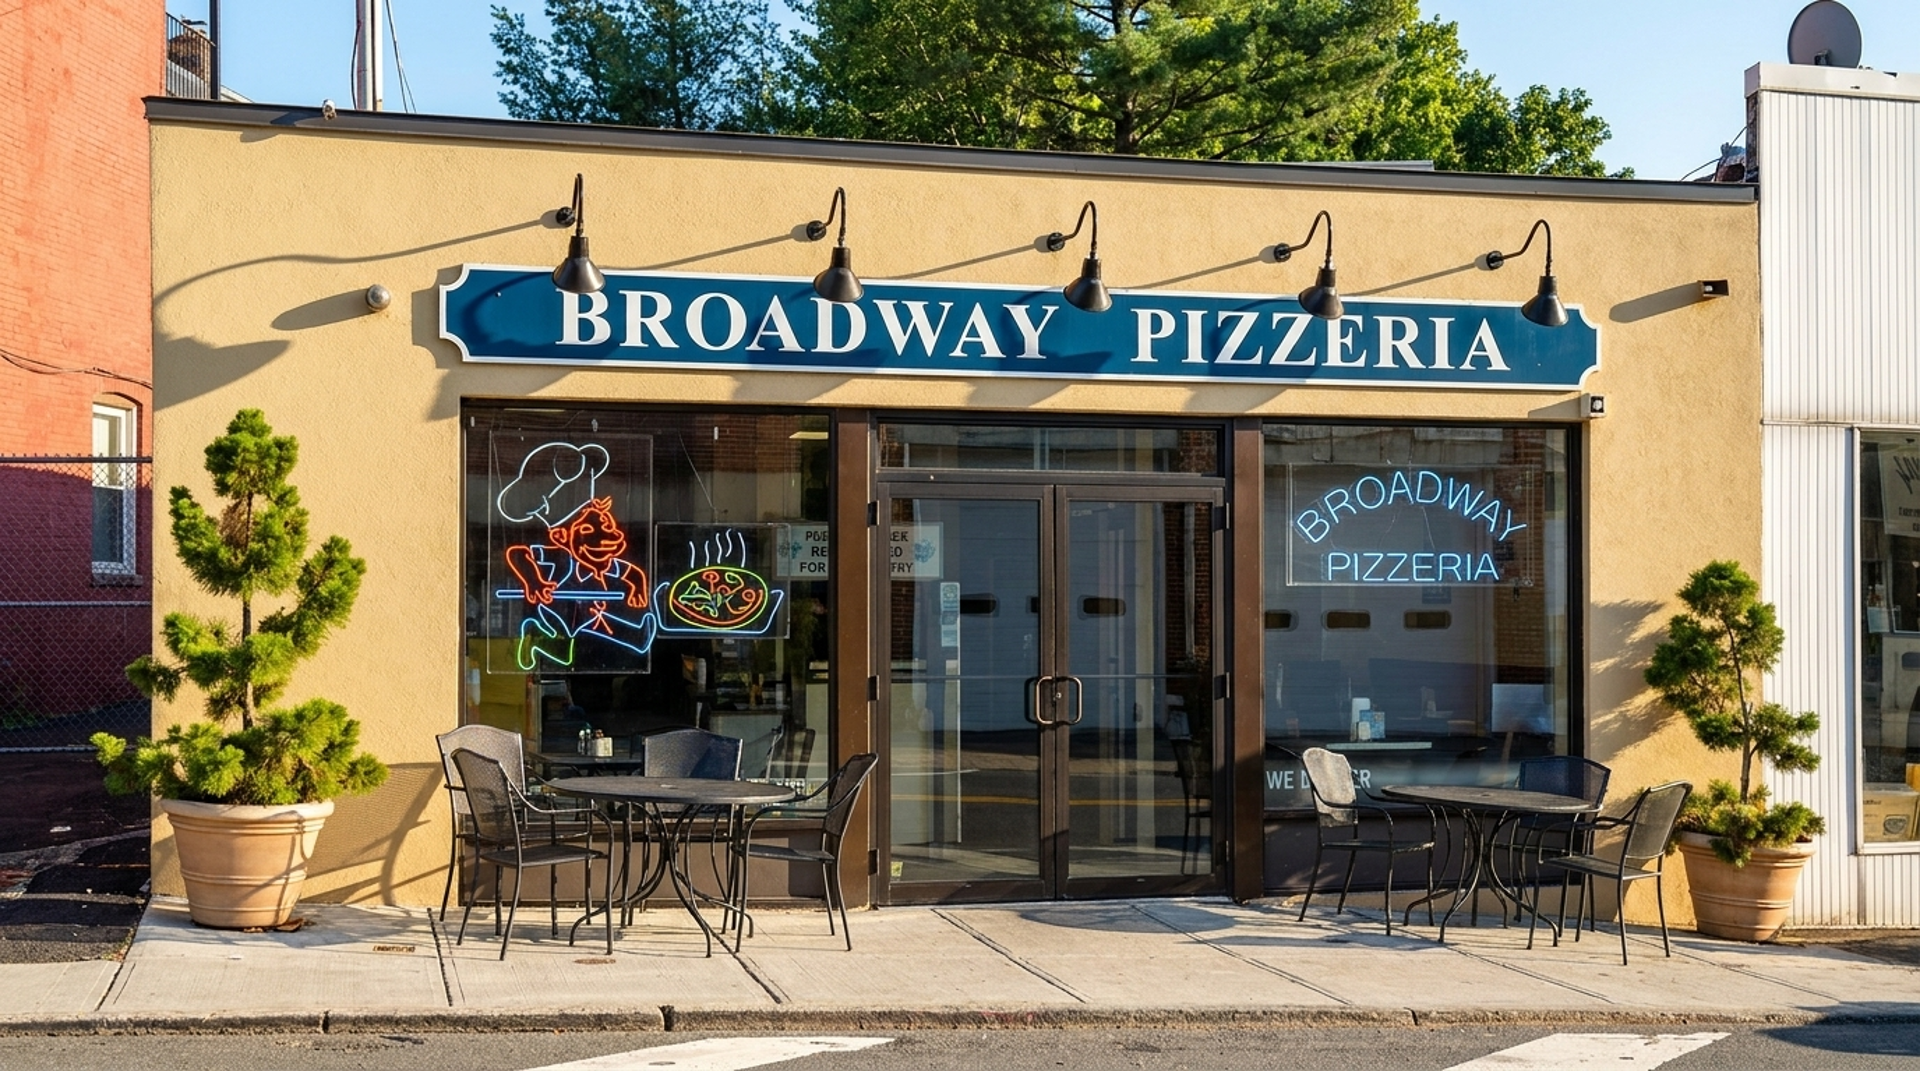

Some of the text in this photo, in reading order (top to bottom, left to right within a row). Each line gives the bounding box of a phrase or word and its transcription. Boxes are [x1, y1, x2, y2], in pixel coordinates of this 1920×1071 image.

[555, 288, 1511, 371] BROADWAY PIZZERIA
[1297, 471, 1527, 543] BROADWAY
[800, 561, 826, 573] FOR
[1327, 553, 1500, 581] PIZZERIA
[1266, 770, 1294, 790] WE
